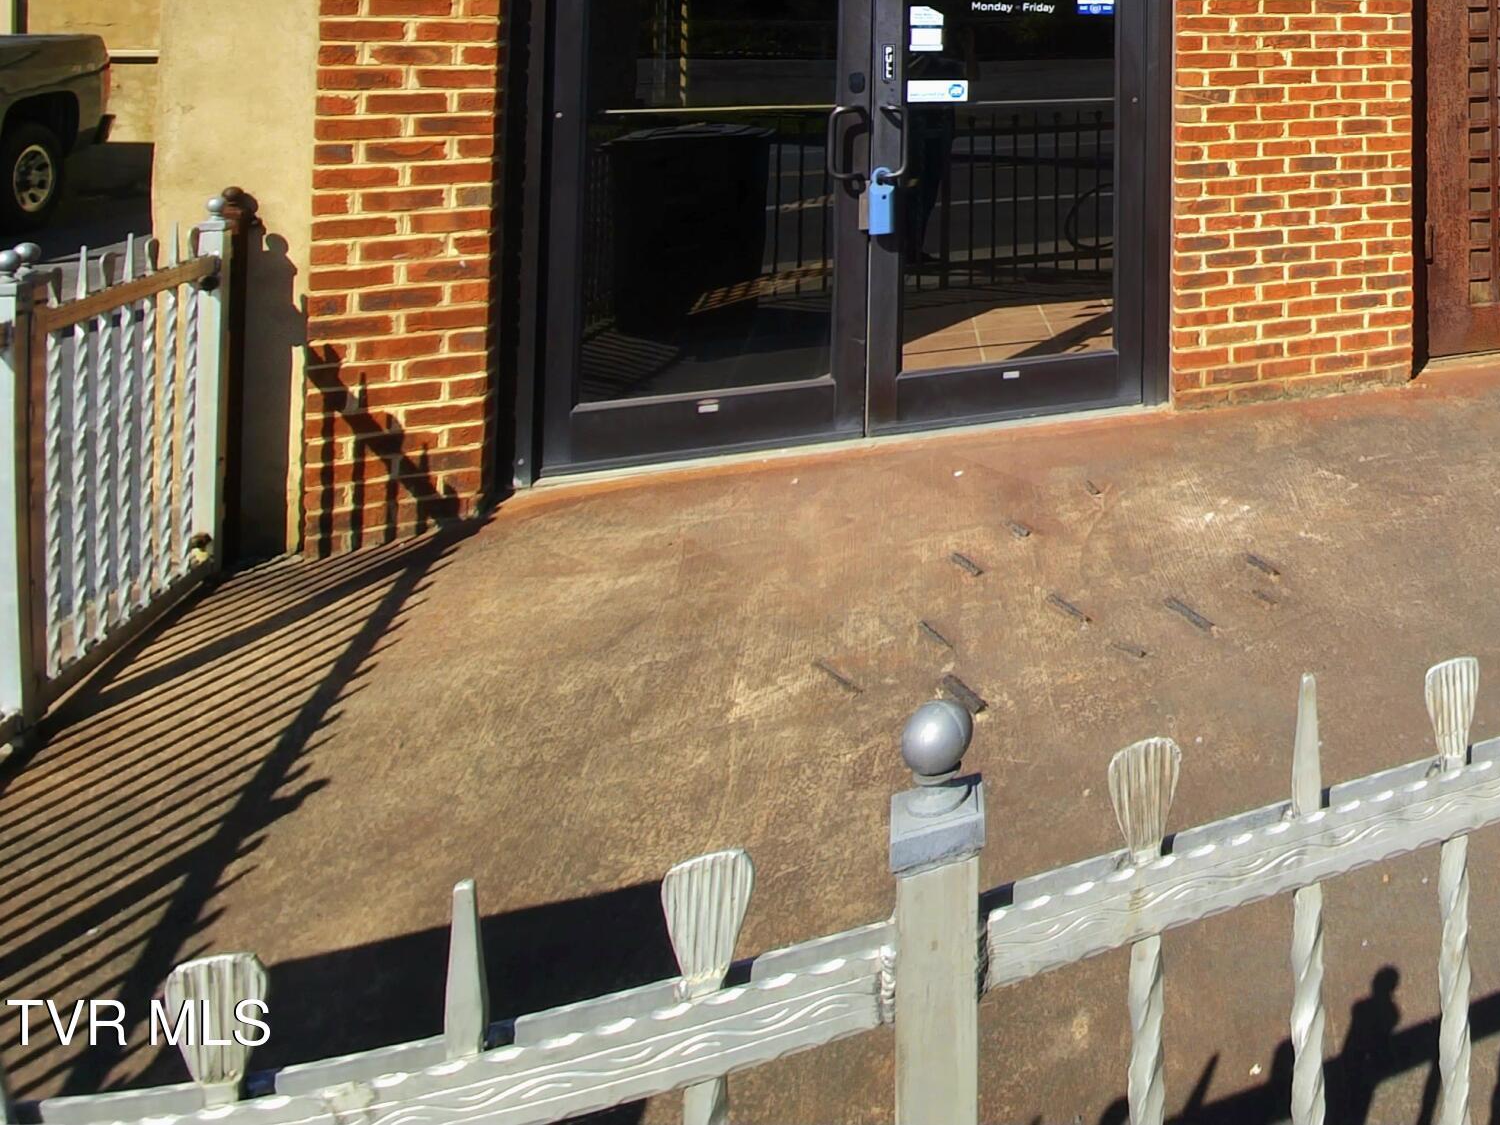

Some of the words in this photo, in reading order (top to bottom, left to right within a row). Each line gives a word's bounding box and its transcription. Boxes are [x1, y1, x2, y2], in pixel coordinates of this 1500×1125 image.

[971, 2, 1013, 13] Monday
[1022, 3, 1055, 13] Friday
[885, 46, 893, 78] PULL
